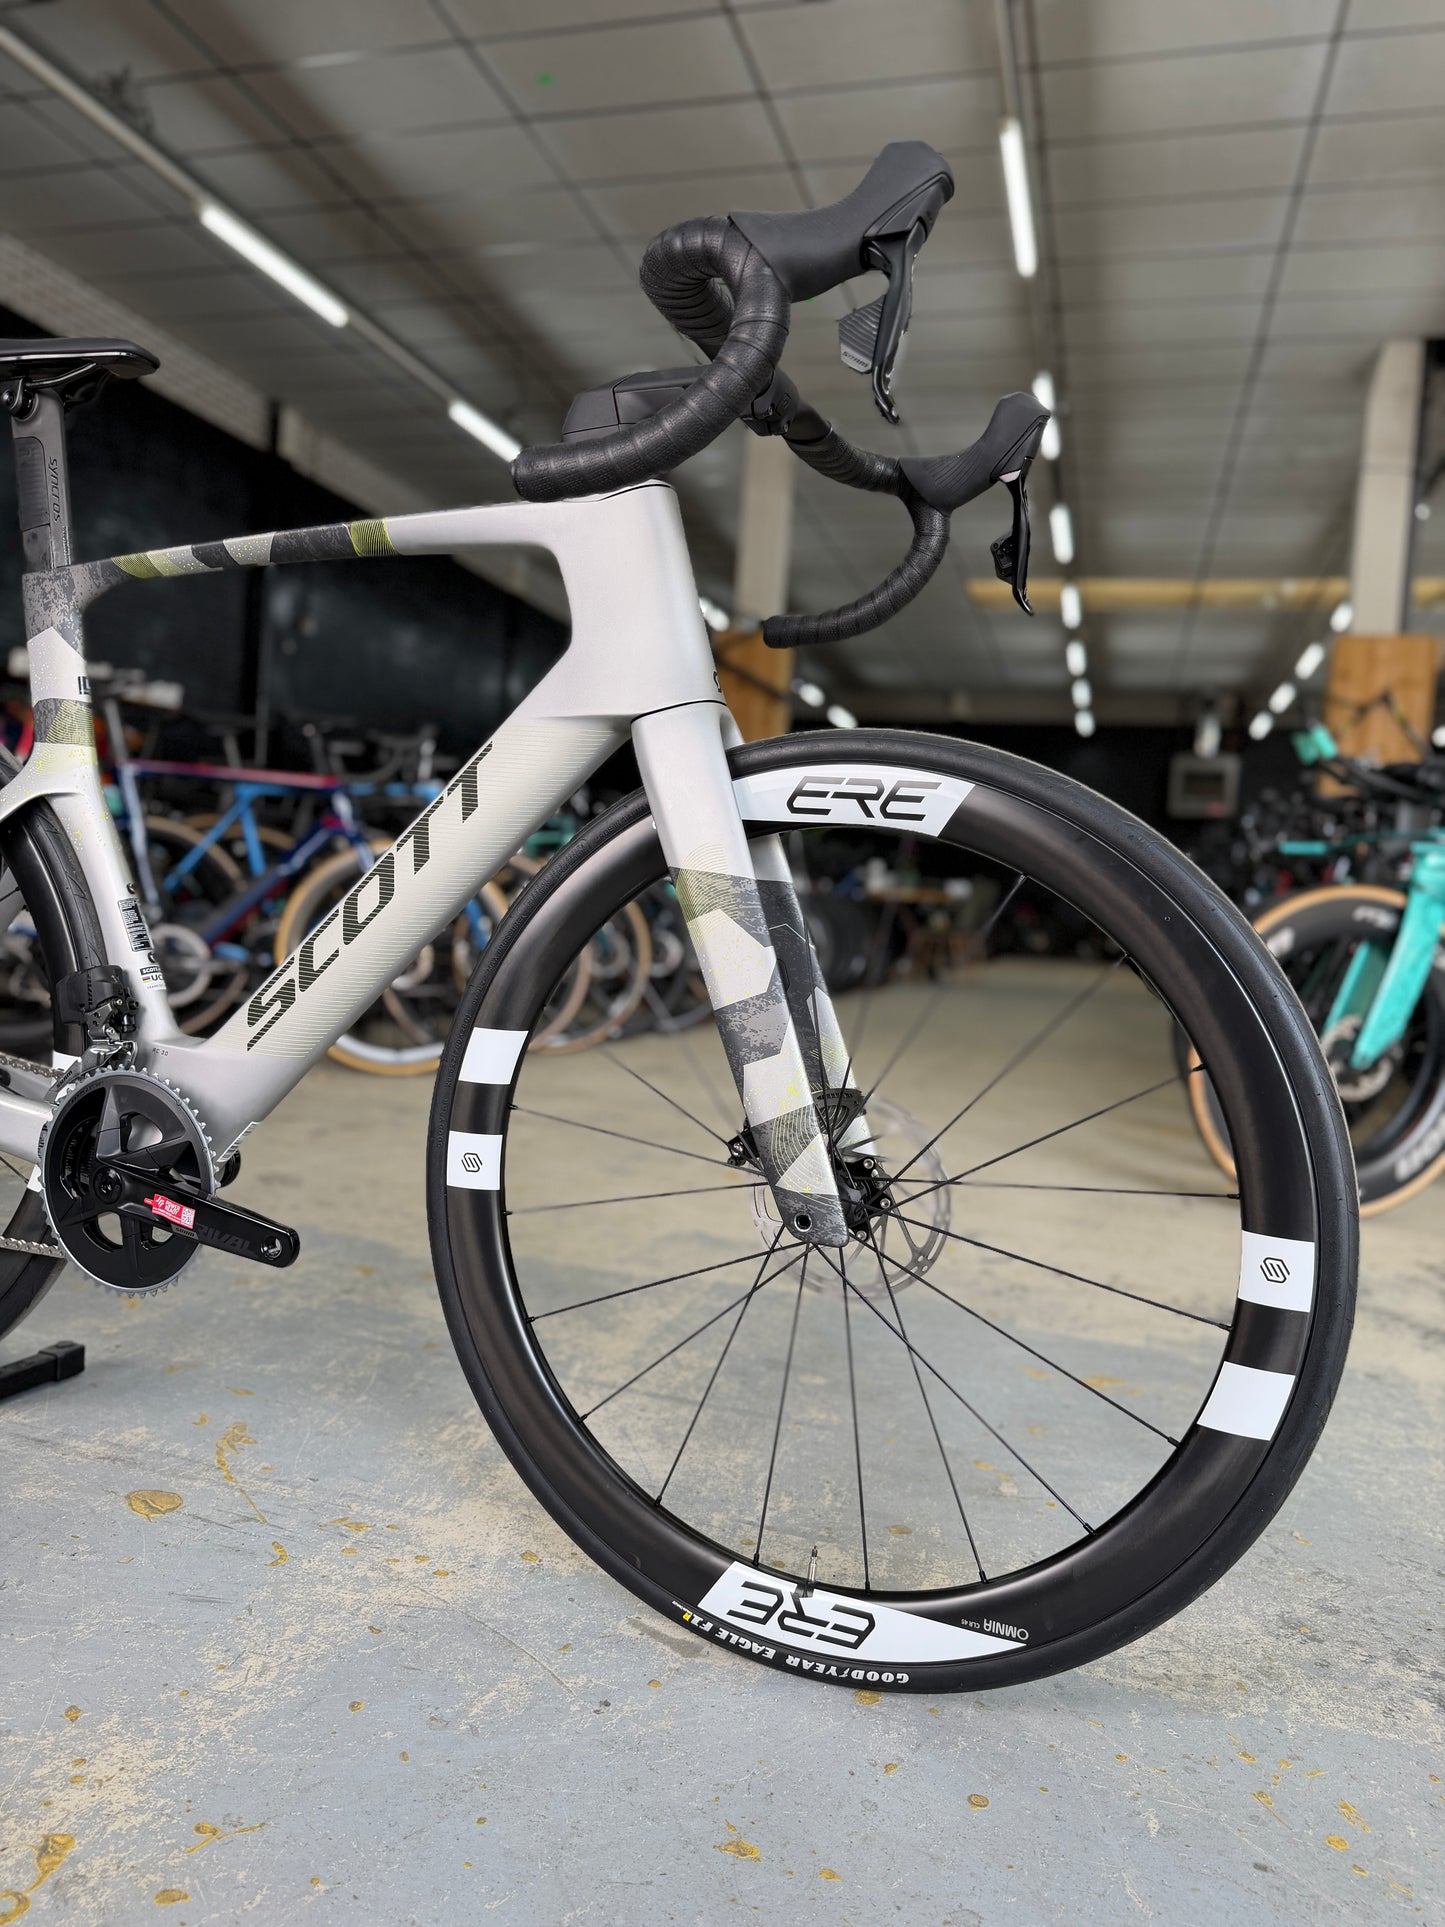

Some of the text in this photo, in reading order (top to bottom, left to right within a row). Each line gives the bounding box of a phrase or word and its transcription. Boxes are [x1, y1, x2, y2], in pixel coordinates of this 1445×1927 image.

[49, 457, 61, 522] SYNCROS
[786, 775, 942, 822] ERE
[246, 740, 493, 1053] SCOTT
[726, 1580, 876, 1650] ERE
[983, 1618, 1029, 1641] OMNIA
[714, 1627, 777, 1660] EAGLE
[785, 1654, 910, 1684] GOODYEAR
